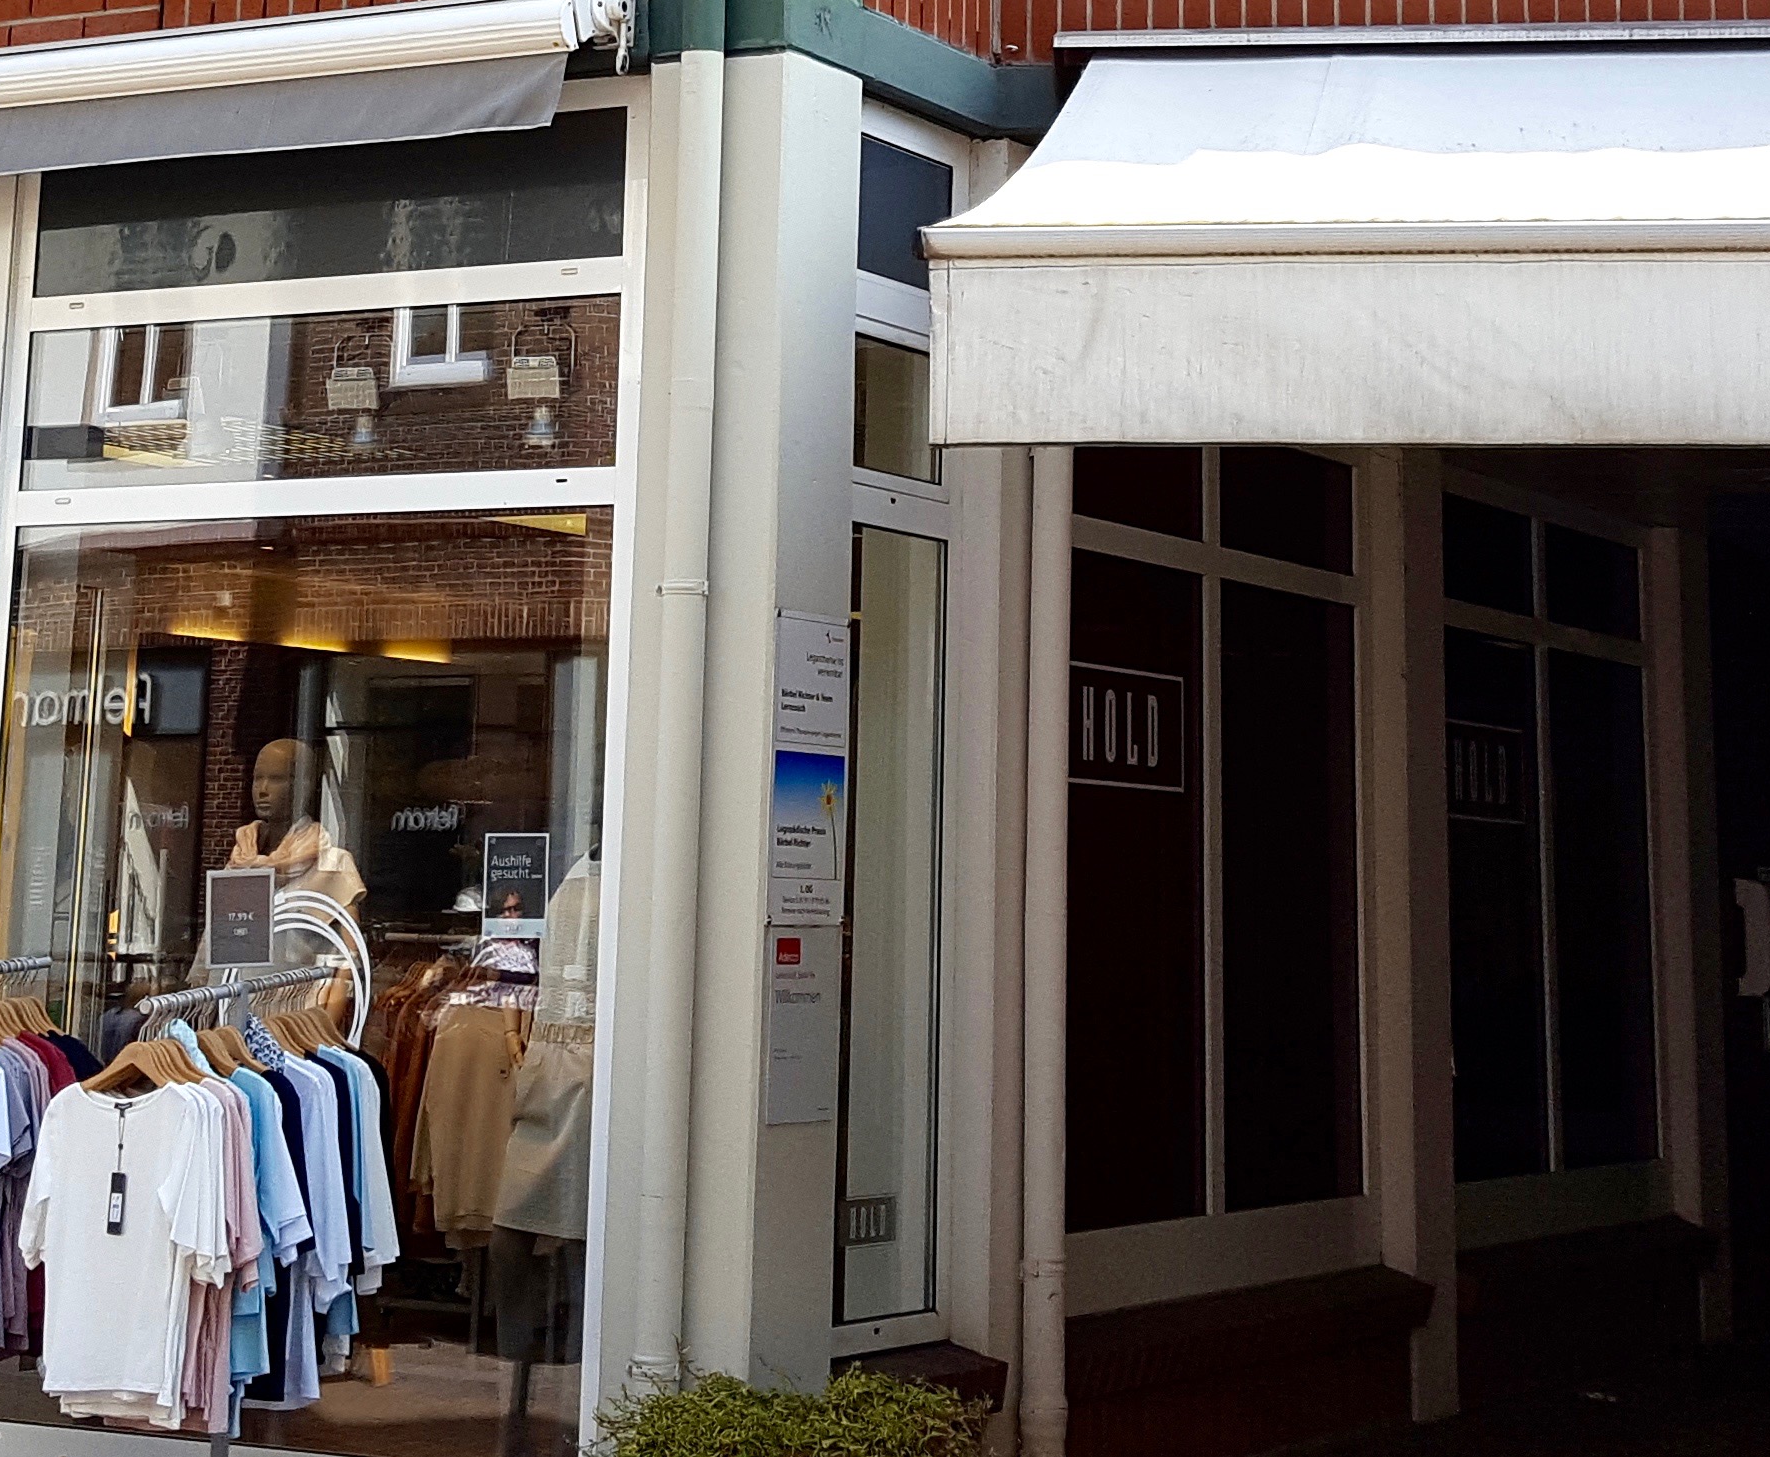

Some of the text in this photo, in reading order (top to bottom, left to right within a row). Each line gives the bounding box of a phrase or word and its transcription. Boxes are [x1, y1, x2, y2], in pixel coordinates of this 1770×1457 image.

[1082, 685, 1159, 768] HOLD
[491, 855, 532, 867] Aushilfe
[491, 868, 530, 882] gesucht
[849, 1204, 886, 1239] HOLD
